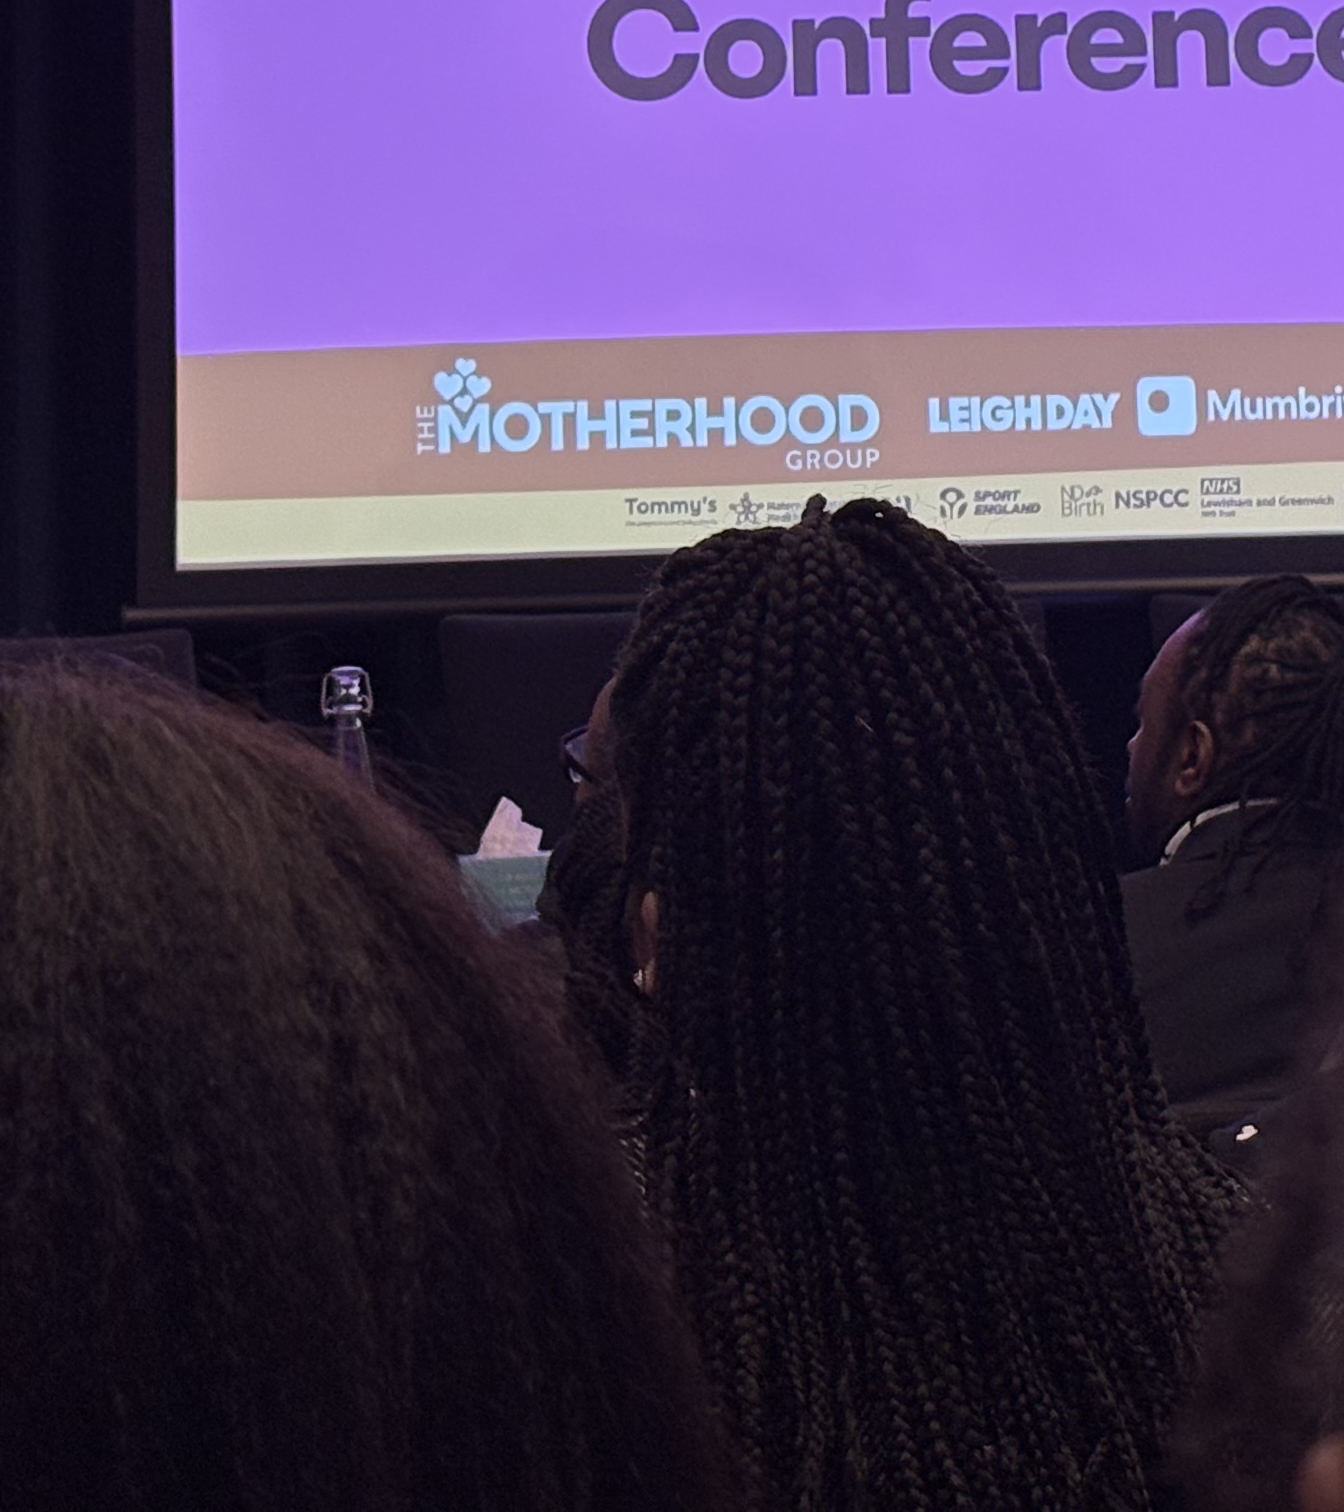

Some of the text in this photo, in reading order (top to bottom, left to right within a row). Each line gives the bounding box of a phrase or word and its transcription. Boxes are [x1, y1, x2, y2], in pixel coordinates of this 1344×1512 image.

[416, 404, 436, 455] THE
[437, 393, 881, 454] MOTHERHOOD
[785, 448, 881, 471] GROUP
[973, 489, 1022, 502] SPORT
[1202, 479, 1239, 494] NHS
[624, 496, 718, 517] Tommy's
[973, 502, 1042, 516] ENGLAND
[1061, 498, 1105, 519] Birth
[1114, 488, 1190, 510] NSPCC
